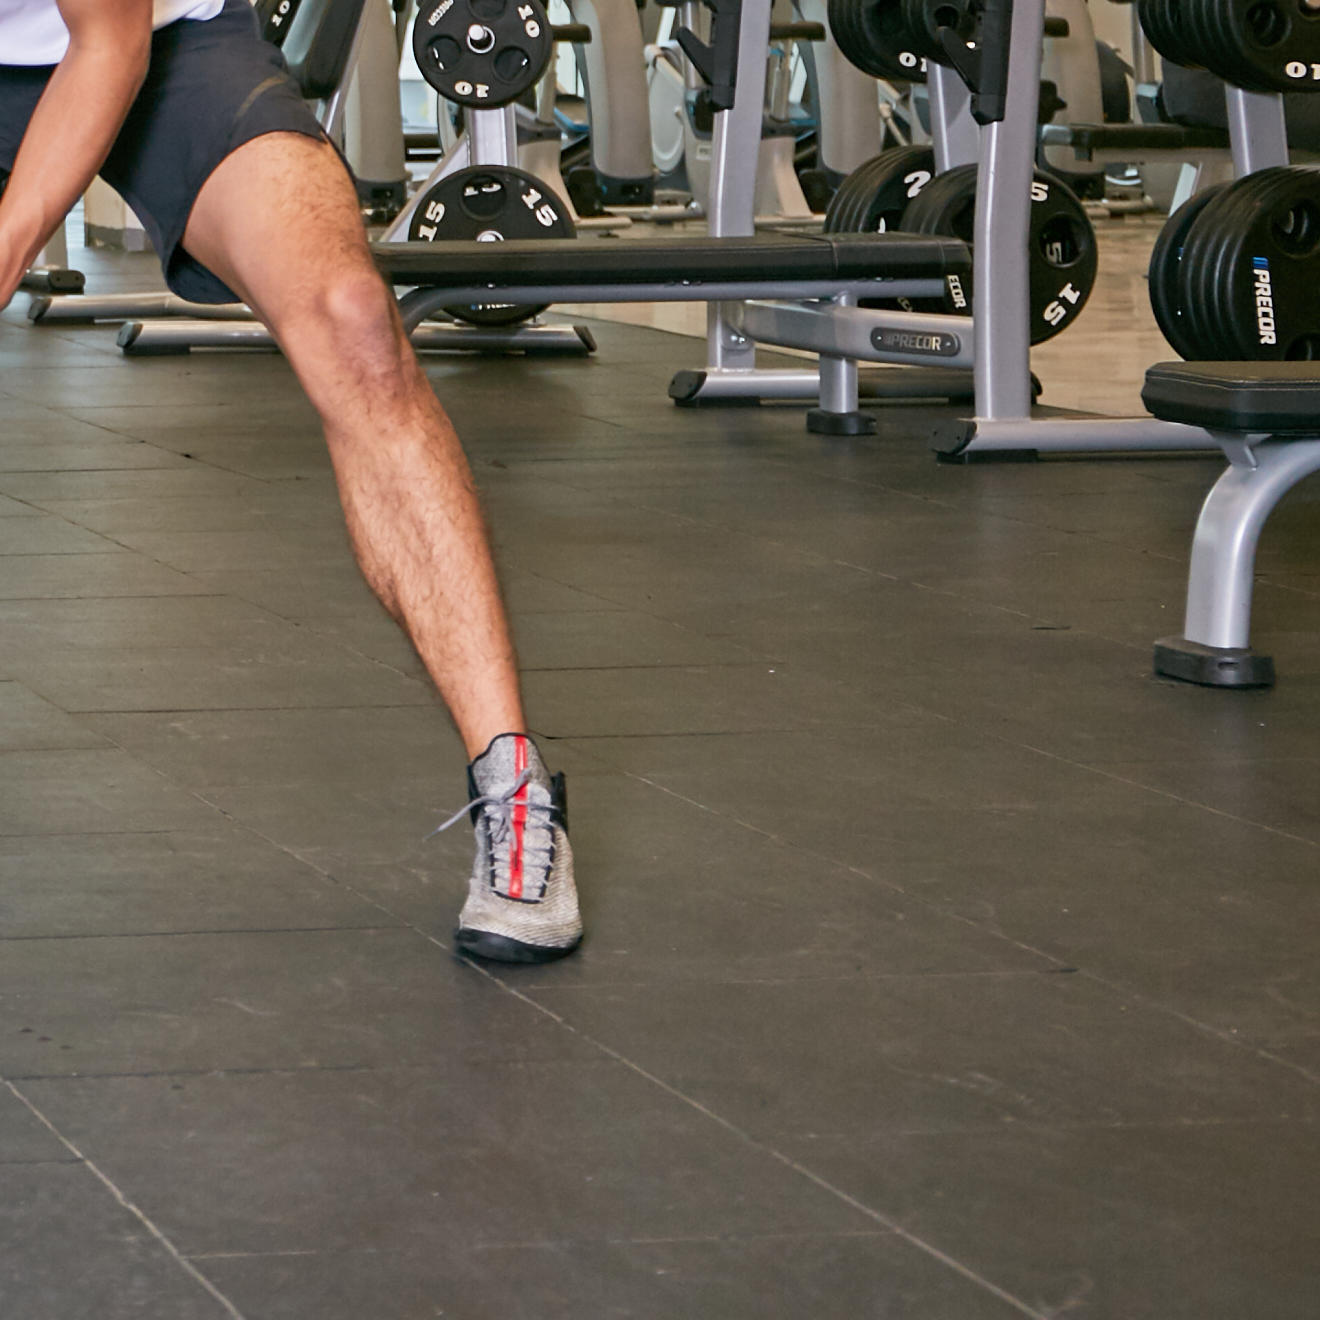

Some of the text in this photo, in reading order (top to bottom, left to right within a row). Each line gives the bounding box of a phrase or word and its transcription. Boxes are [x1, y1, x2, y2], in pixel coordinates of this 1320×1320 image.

[271, 0, 291, 27] 10
[517, 4, 540, 38] 10
[454, 81, 490, 98] 10
[418, 200, 446, 242] 15
[521, 188, 559, 227] 15
[947, 274, 967, 308] ECOR
[1043, 282, 1080, 326] 15
[1253, 268, 1277, 345] PRECOR
[891, 333, 942, 352] PRECOR
